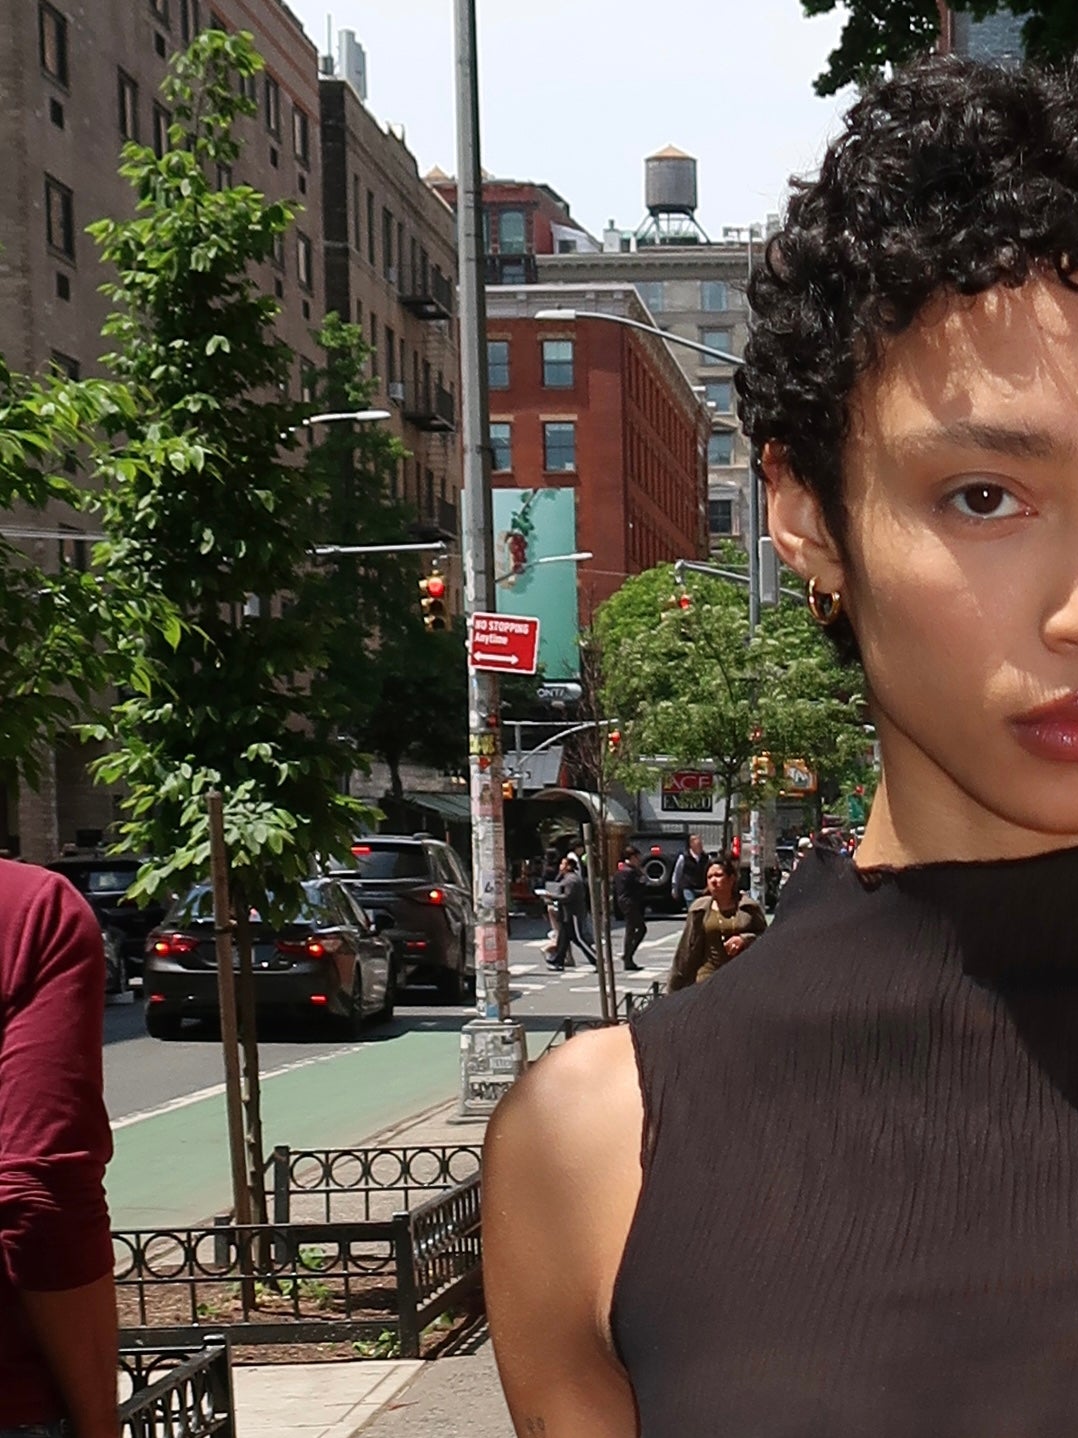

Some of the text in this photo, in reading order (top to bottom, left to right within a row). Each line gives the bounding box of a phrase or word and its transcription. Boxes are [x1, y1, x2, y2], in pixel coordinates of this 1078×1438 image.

[474, 619, 530, 635] NO STOPPING
[474, 631, 509, 646] Anytime
